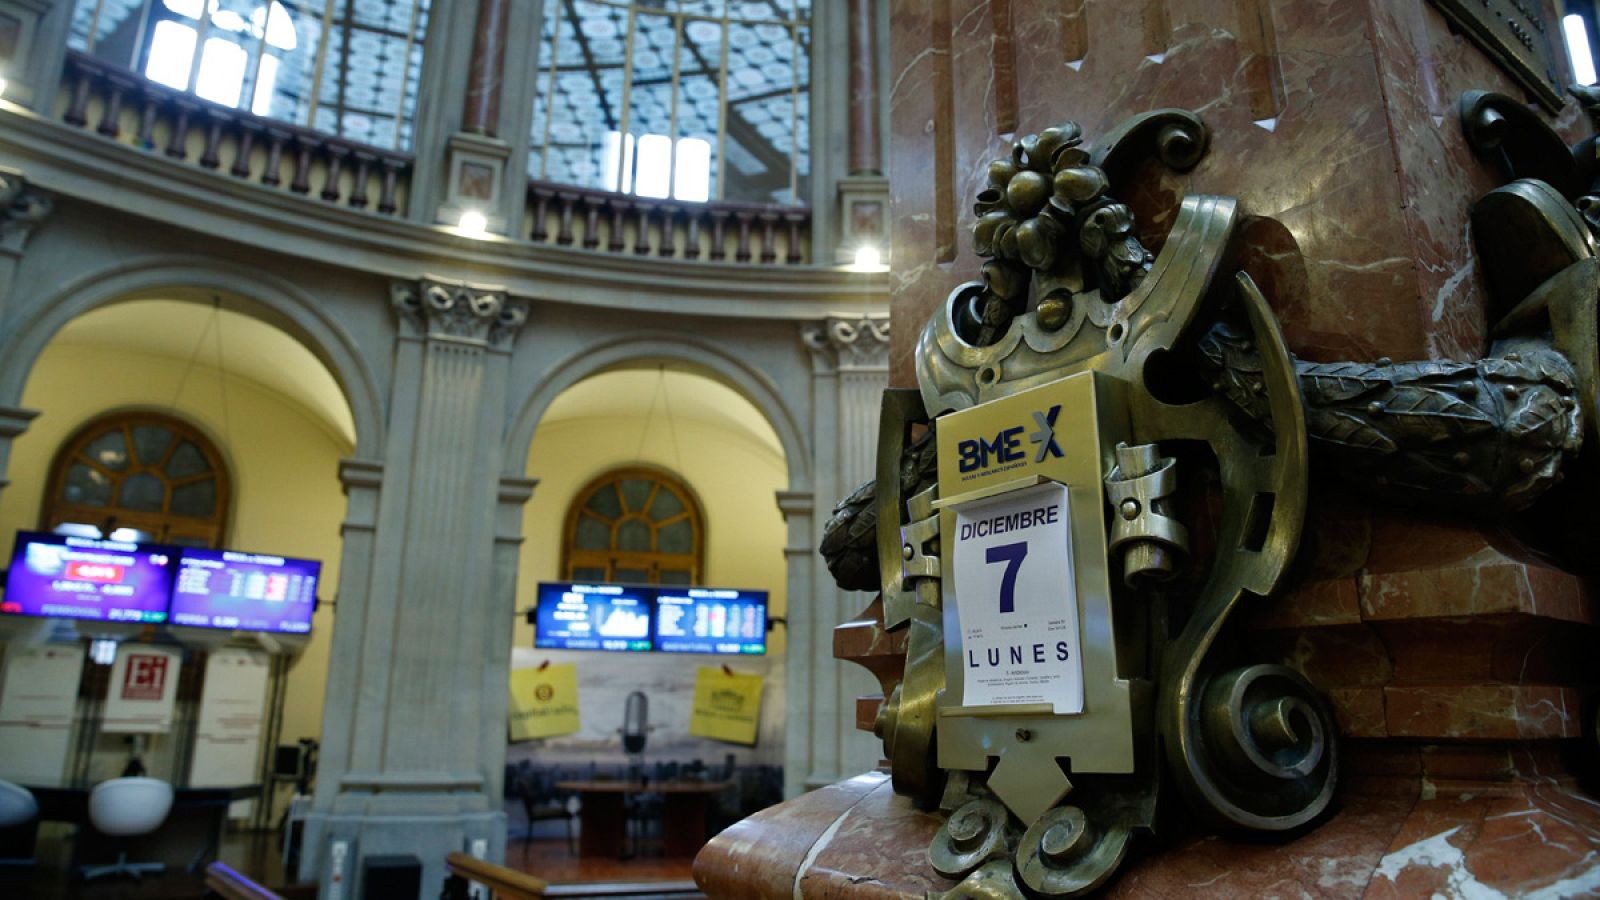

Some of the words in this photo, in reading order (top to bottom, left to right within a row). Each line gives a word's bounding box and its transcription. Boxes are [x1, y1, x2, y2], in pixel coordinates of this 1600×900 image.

[958, 426, 1025, 473] BME
[960, 505, 1059, 541] DICIEMBRE
[985, 541, 1028, 614] 7
[969, 641, 1069, 668] LUNES
